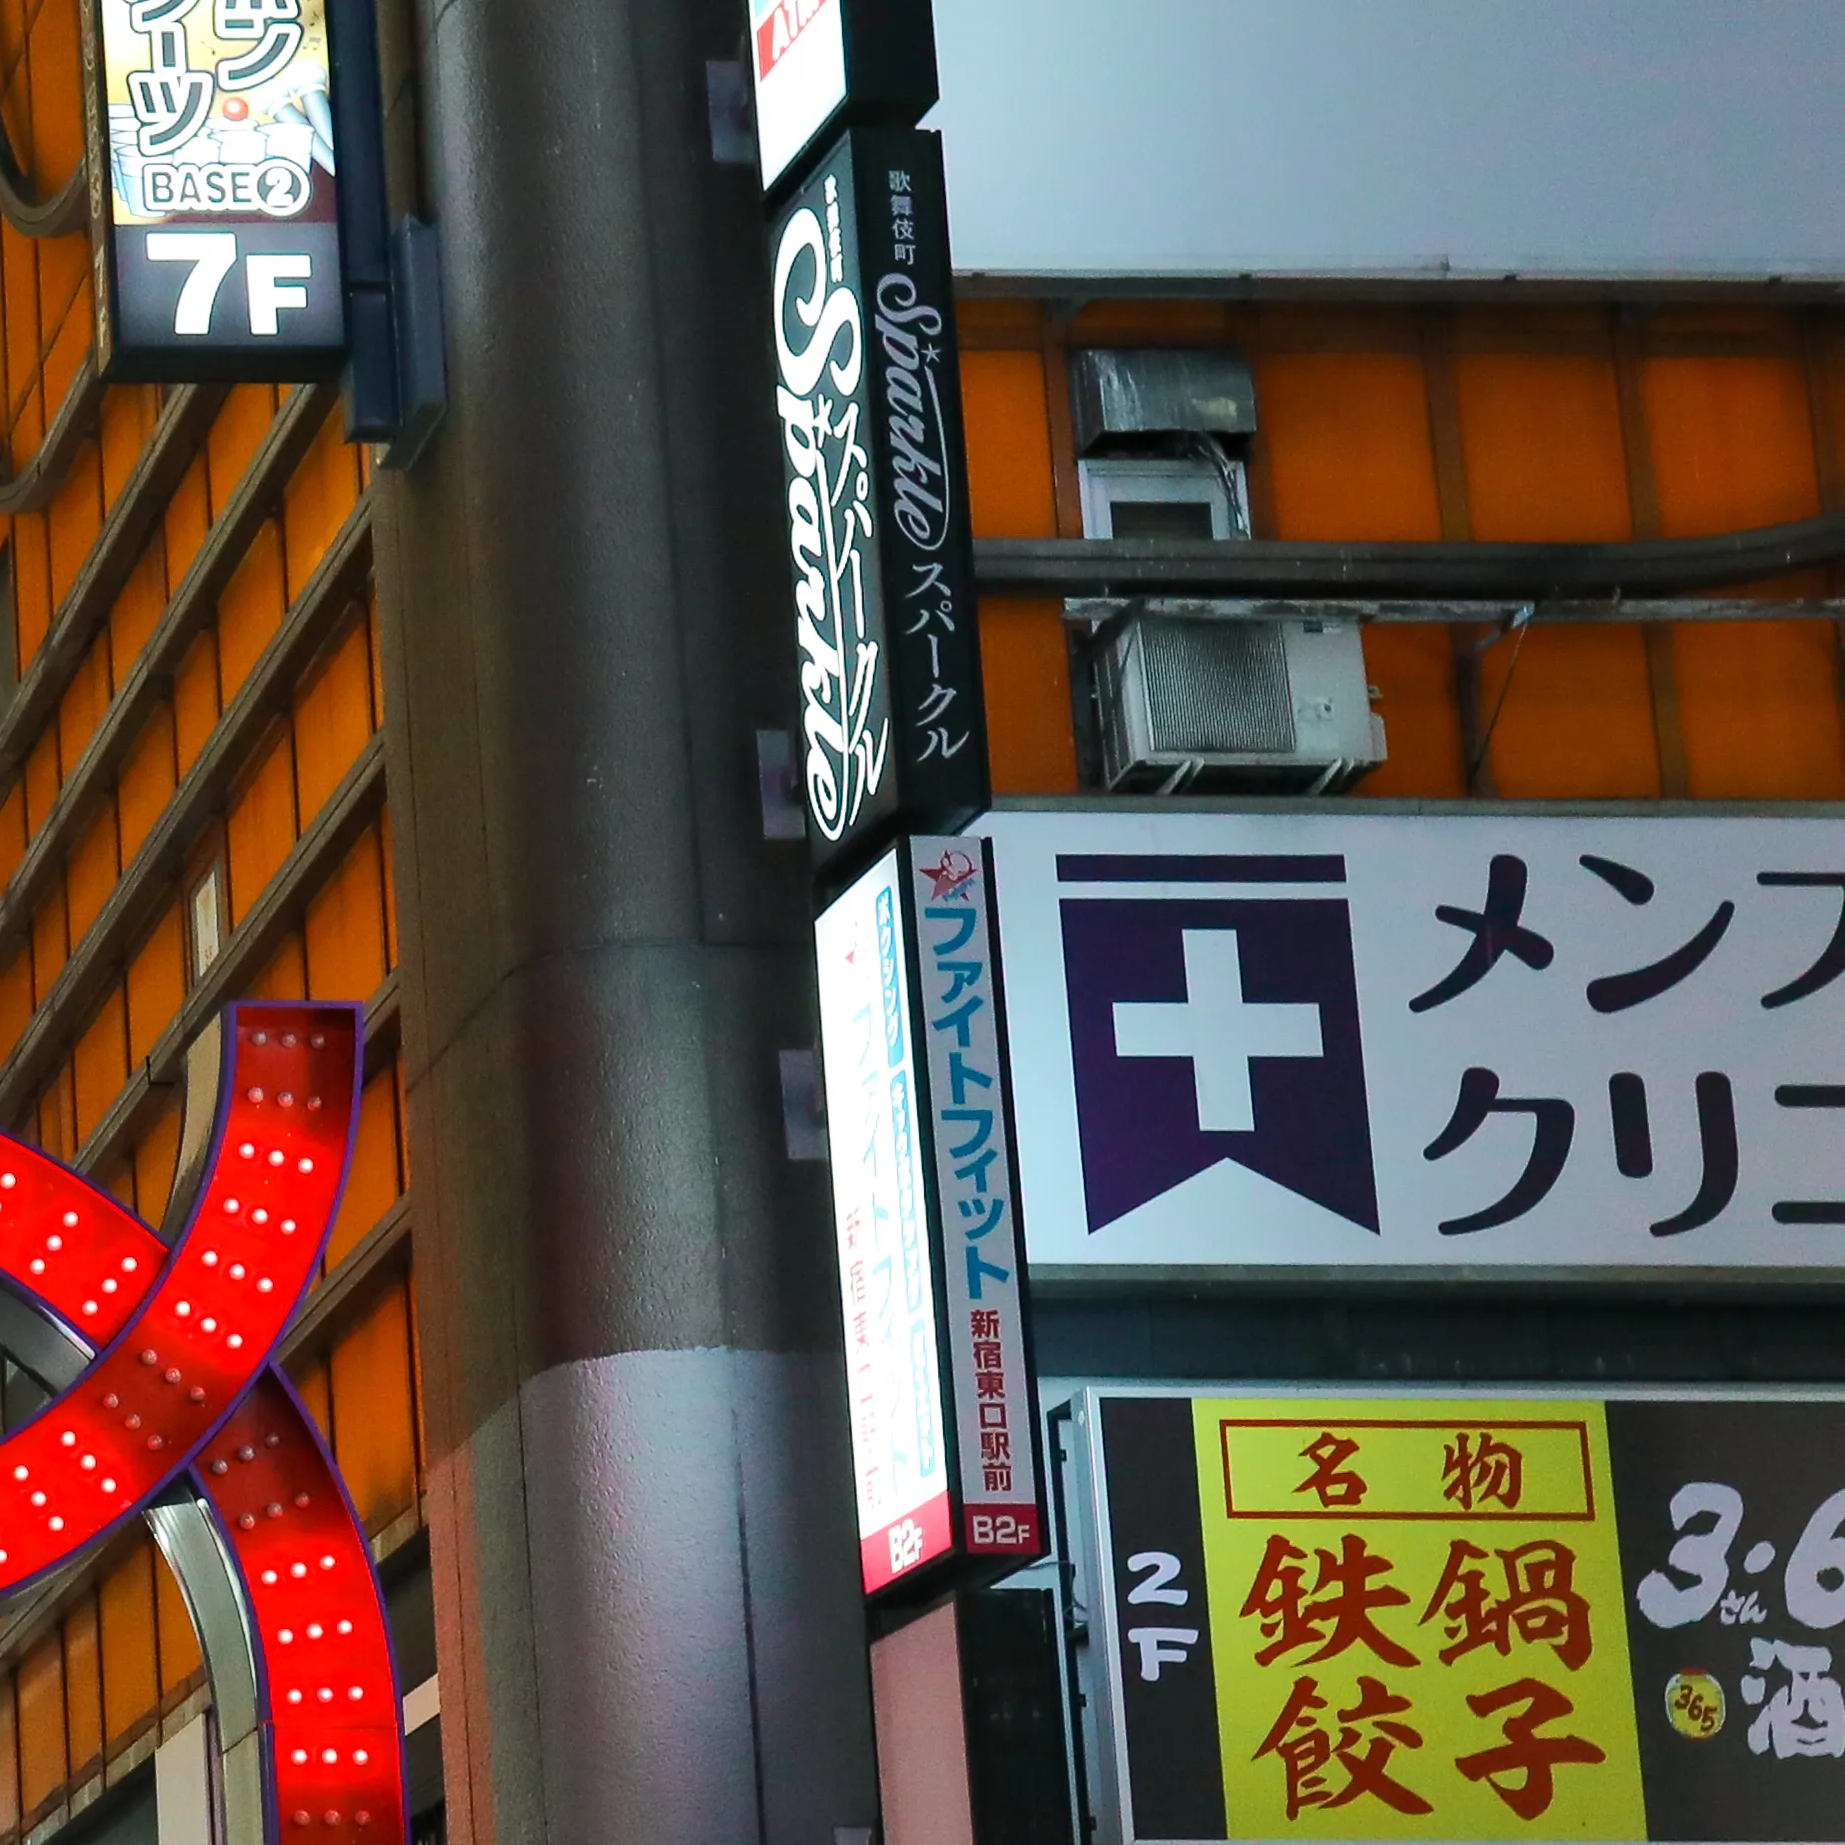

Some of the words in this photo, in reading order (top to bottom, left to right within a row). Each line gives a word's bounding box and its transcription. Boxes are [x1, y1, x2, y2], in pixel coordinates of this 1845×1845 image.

[145, 232, 312, 336] 7F
[876, 271, 950, 552] Sparkle
[774, 206, 864, 843] Sparkle
[830, 404, 892, 828] スパークル
[905, 563, 970, 764] スパークル
[923, 906, 1011, 1301] ファイトフィット
[969, 1308, 1013, 1493] 新宿東口駅前
[1292, 1431, 1523, 1512] 名物
[972, 1514, 1031, 1545] B2F
[1238, 1532, 1593, 1673] 鉄鍋
[1126, 1551, 1199, 1682] 2F
[1250, 1675, 1607, 1822] 餃子
[1673, 1682, 1718, 1734] 365
